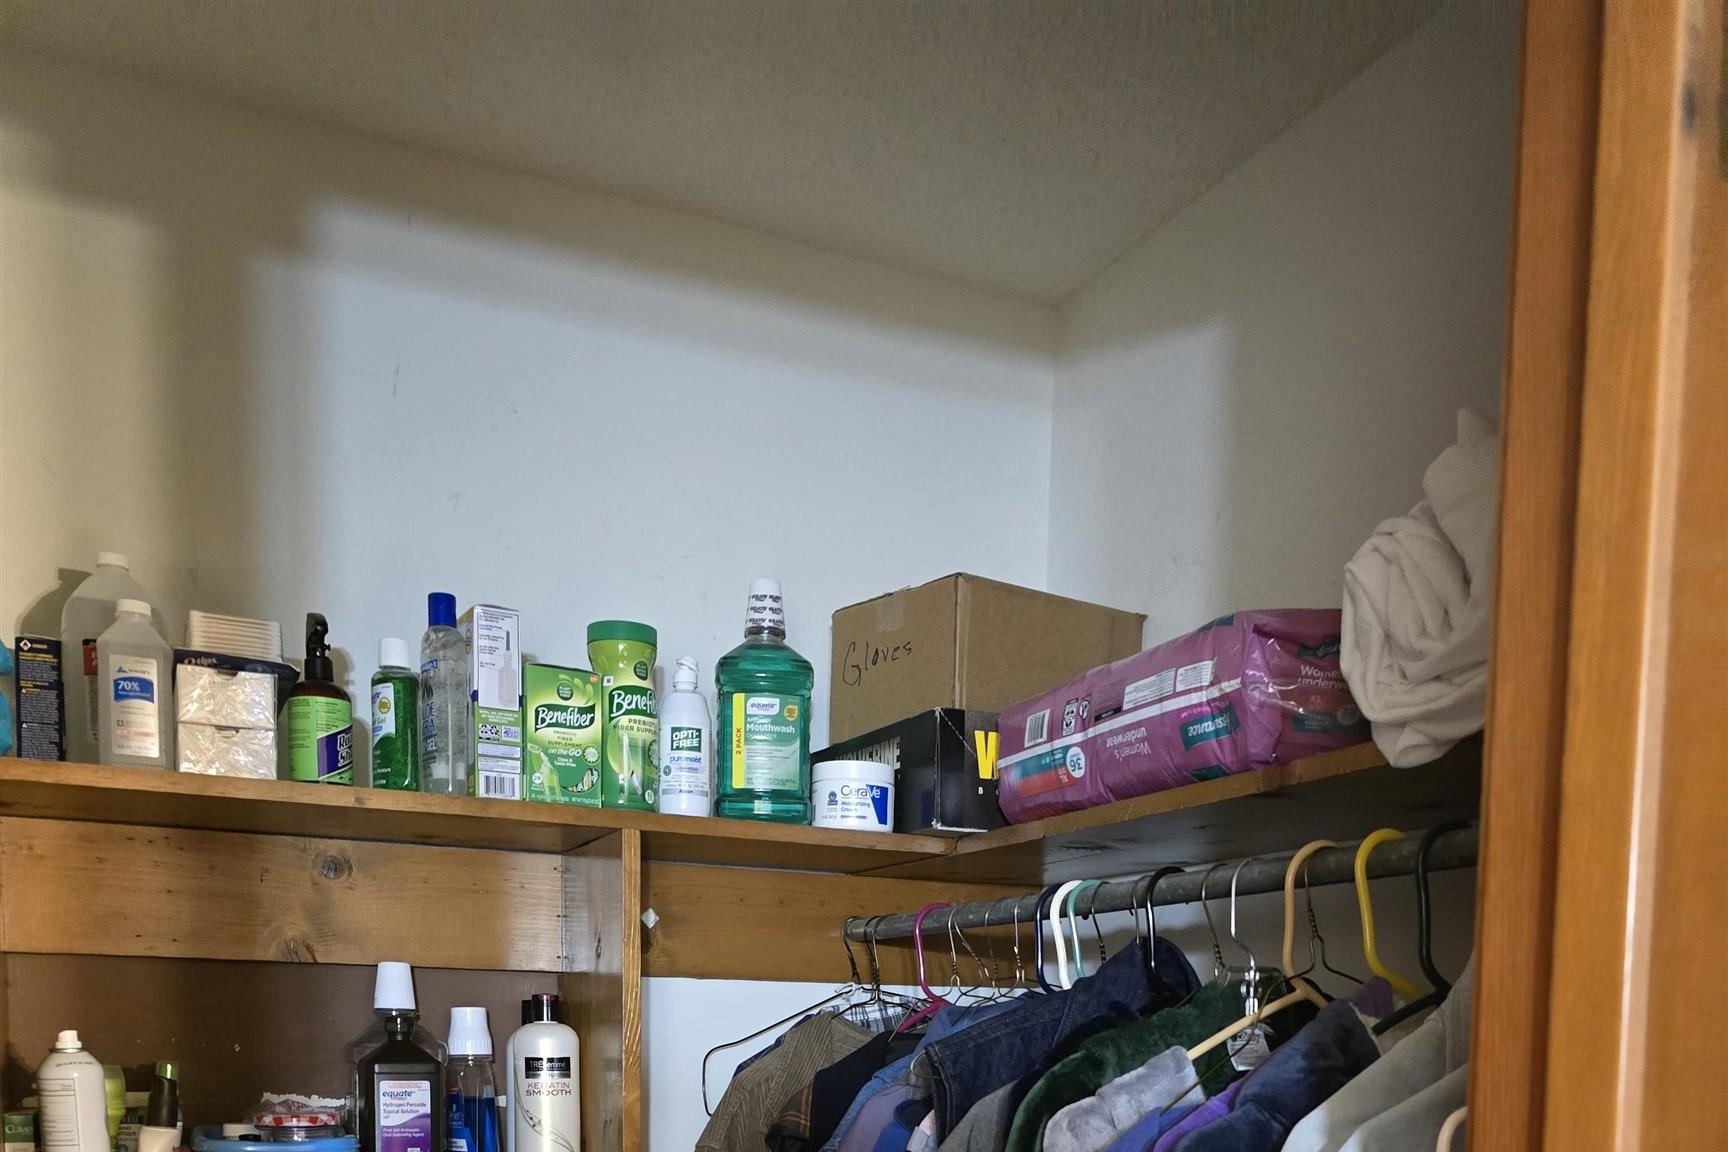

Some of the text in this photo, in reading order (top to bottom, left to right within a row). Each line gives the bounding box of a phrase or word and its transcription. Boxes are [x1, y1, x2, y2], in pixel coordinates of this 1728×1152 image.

[842, 641, 912, 686] Gloves
[118, 680, 140, 691] 70%
[536, 706, 595, 729] Benefiber
[747, 723, 796, 734] Mouthwash
[672, 729, 700, 740] OPTI-
[1105, 727, 1147, 748] underwear
[672, 738, 700, 749] FREE
[568, 748, 582, 757] GO
[1069, 757, 1083, 772] 36
[840, 784, 881, 799] CeraVe
[382, 1090, 413, 1099] equate
